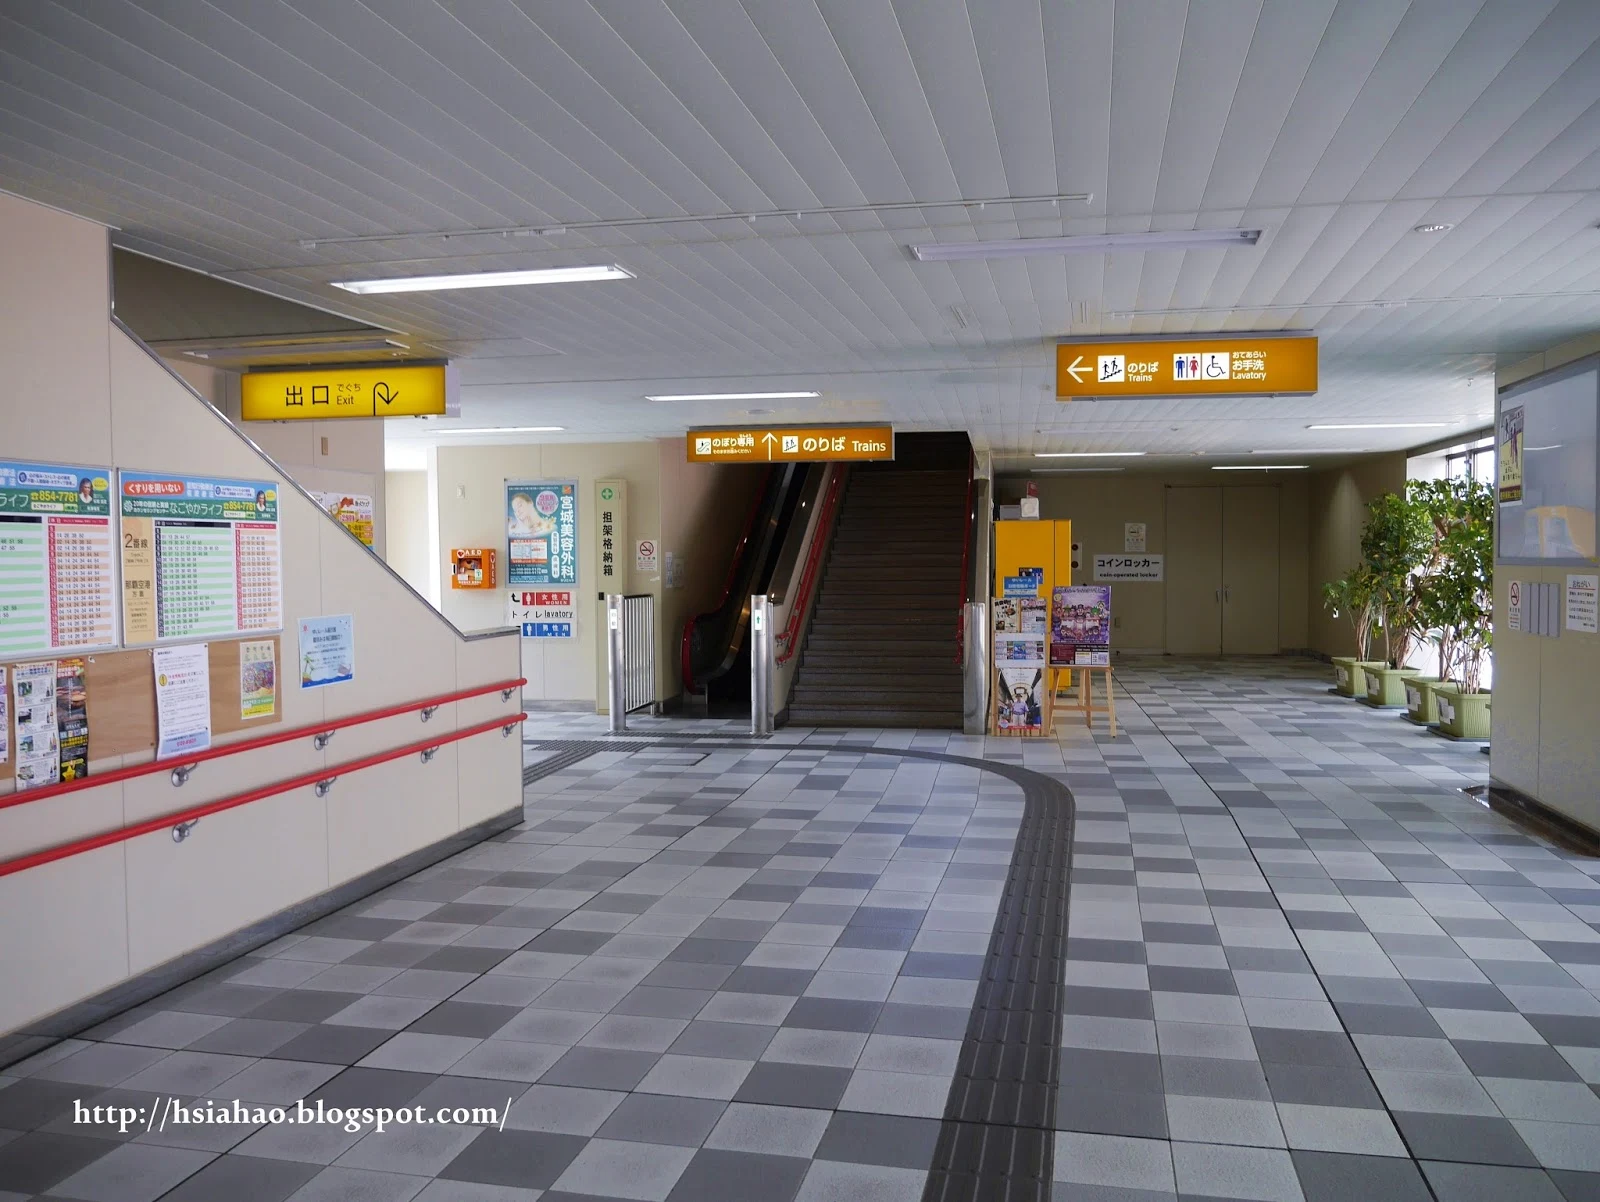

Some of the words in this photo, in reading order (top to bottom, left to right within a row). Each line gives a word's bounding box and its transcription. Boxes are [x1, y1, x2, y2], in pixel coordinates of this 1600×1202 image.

[1128, 362, 1158, 372] のりば
[1232, 360, 1264, 371] お手洗
[1128, 374, 1152, 382] Trains
[1232, 372, 1266, 381] Lavatory
[336, 383, 361, 392] でぐち
[286, 385, 330, 406] 出口
[336, 396, 354, 406] Exit
[712, 438, 754, 447] のぼり専用
[802, 436, 846, 452] のりば
[852, 440, 886, 452] Trains
[128, 483, 181, 493] くすりを用いない
[39, 490, 78, 502] 854-7781
[169, 502, 223, 515] なごやかライフ
[125, 534, 148, 548] 2番線
[560, 496, 574, 578] 宮城美容外科
[602, 511, 613, 576] 担架格納箱
[1098, 558, 1159, 567] コインロッカー
[125, 580, 150, 589] 那覇空港
[512, 610, 542, 618] トイレ
[544, 610, 573, 618] lavatory
